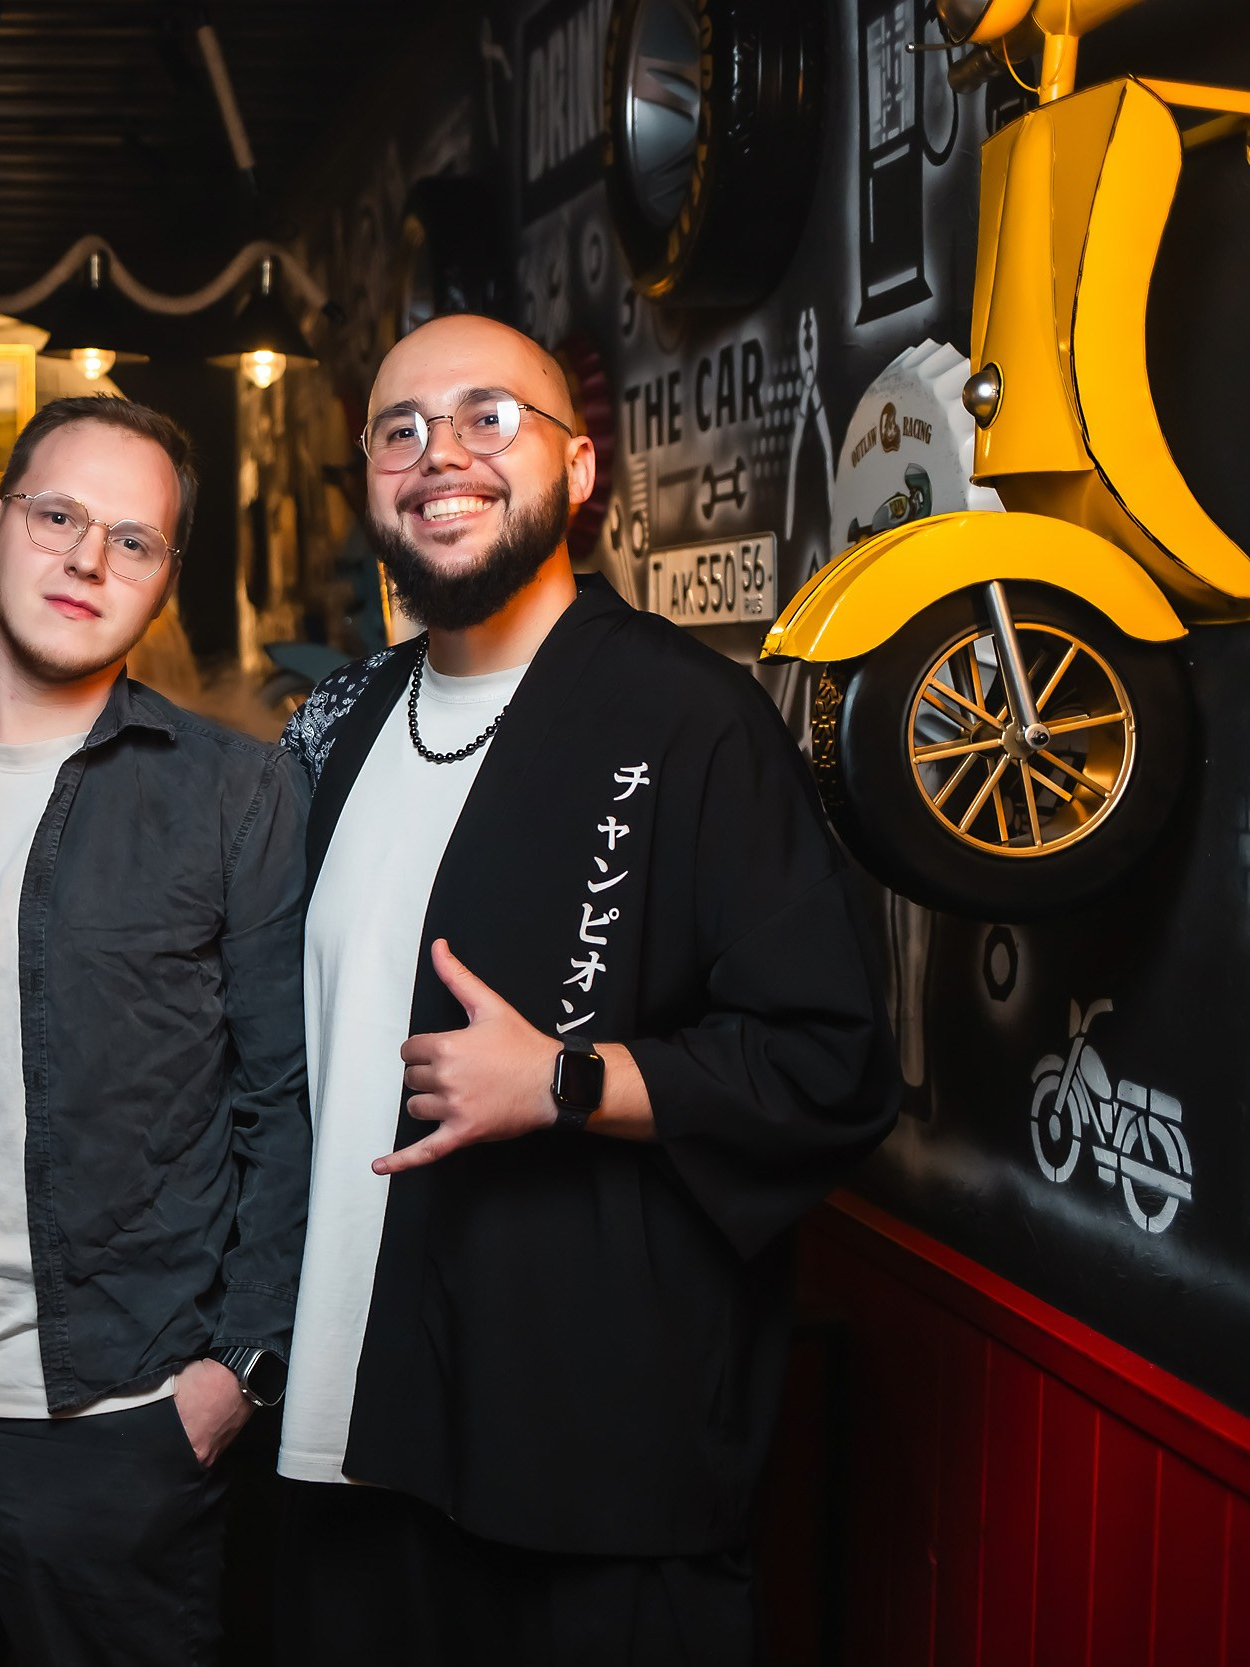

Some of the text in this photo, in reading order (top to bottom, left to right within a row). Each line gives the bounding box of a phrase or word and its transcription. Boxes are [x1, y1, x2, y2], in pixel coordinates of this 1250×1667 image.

[625, 338, 764, 454] THE CAR
[851, 416, 932, 468] OUTLAW RACING
[741, 544, 765, 592] 56
[556, 762, 650, 1034] チャンピオン
